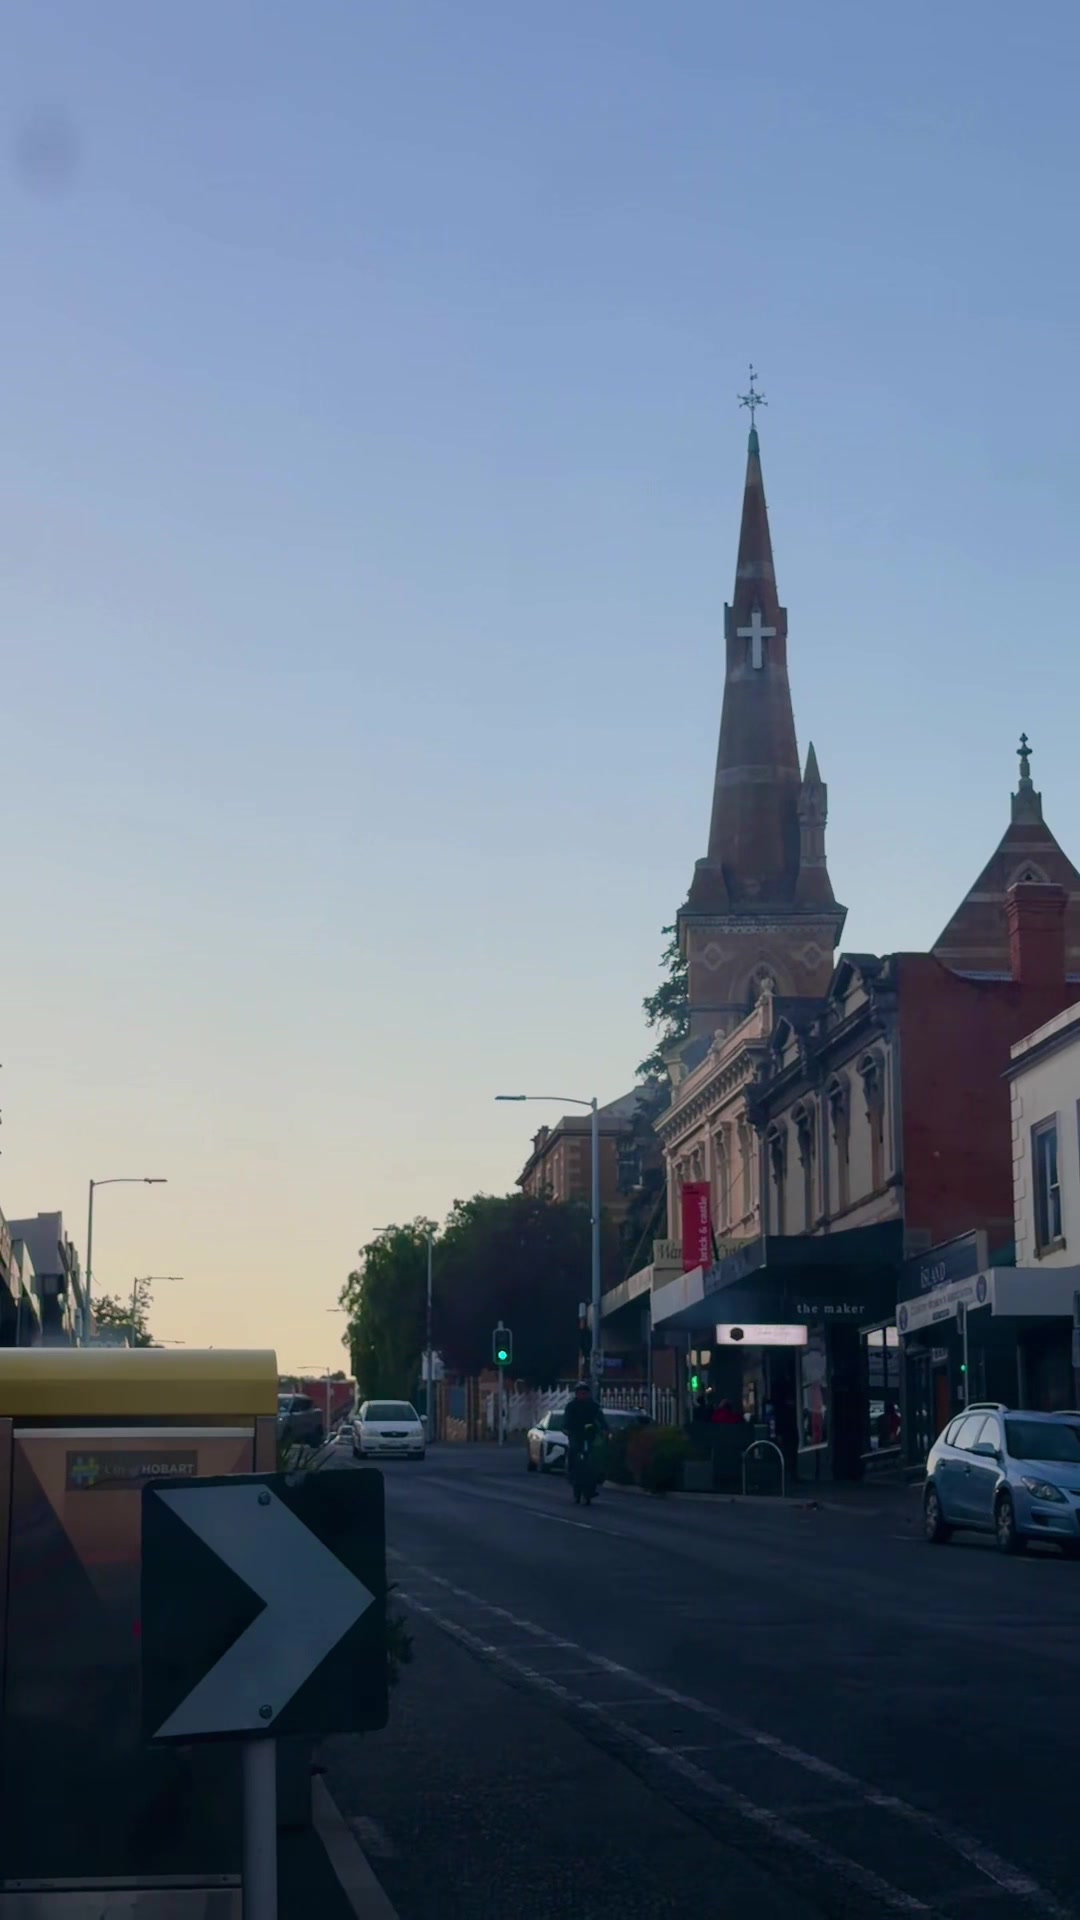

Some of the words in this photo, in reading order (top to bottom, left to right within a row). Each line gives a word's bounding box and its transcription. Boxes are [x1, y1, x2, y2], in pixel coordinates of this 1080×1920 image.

[698, 1195, 708, 1224] castle
[698, 1226, 708, 1234] &
[698, 1236, 708, 1262] brick
[796, 1303, 818, 1314] the
[823, 1302, 865, 1314] maker
[141, 1463, 194, 1475] HOBART
